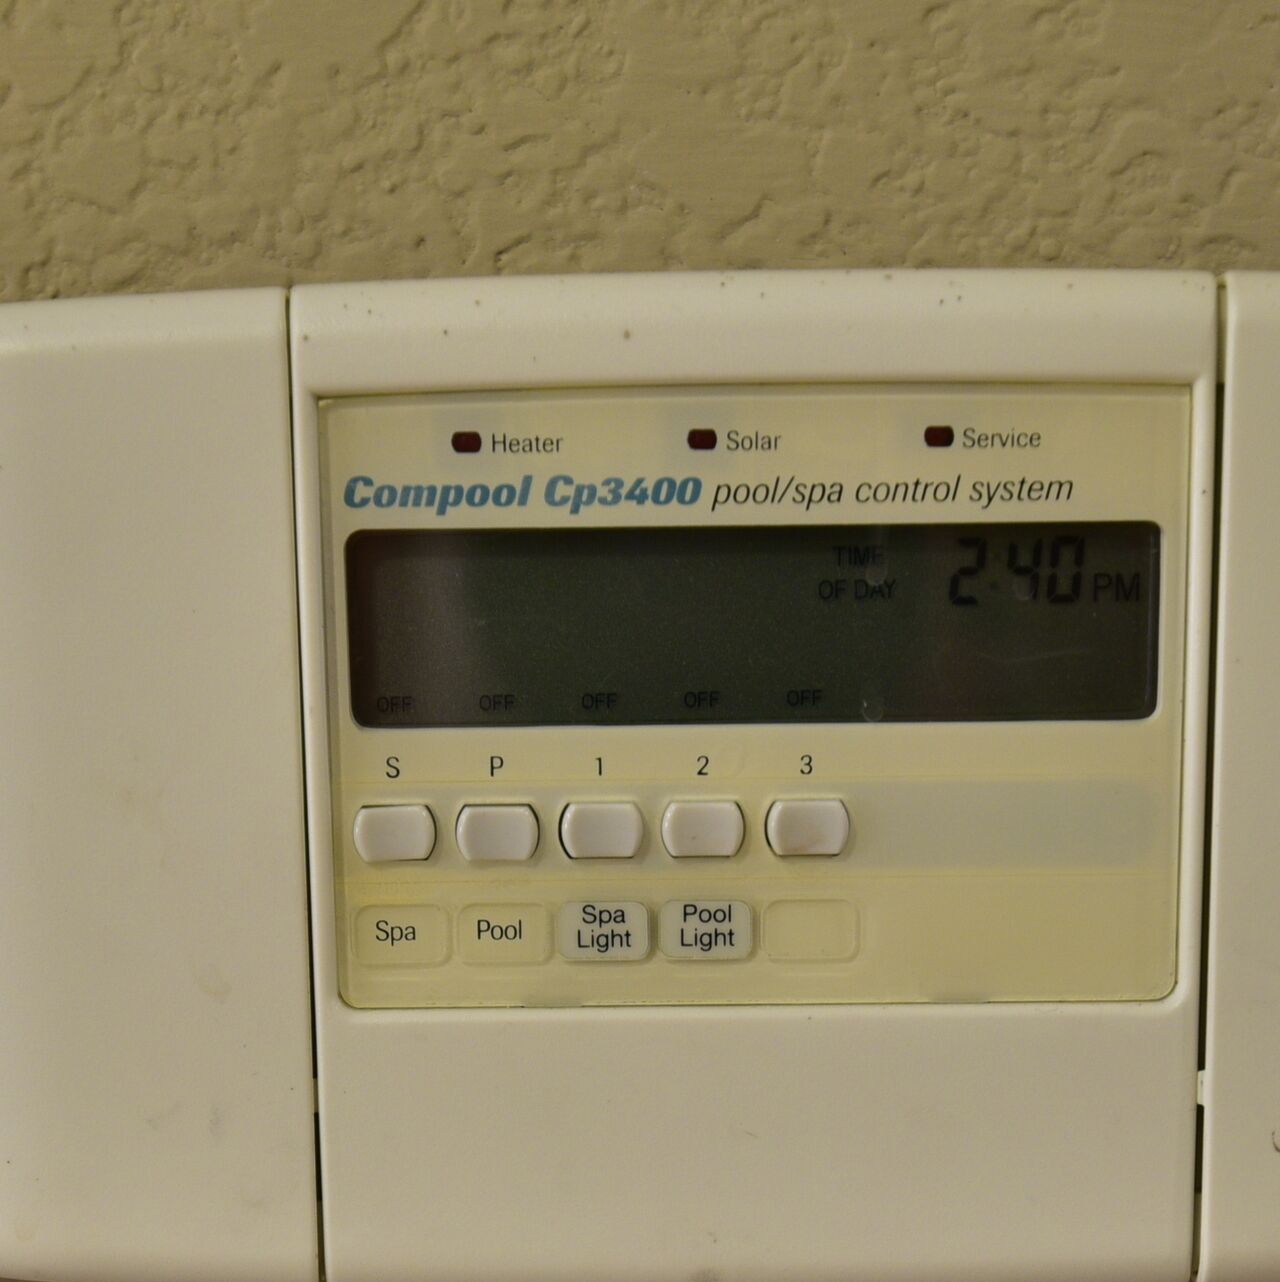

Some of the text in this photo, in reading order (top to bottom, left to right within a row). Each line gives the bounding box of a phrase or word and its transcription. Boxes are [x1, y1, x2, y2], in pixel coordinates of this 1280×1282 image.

[491, 431, 563, 455] Heater
[725, 428, 781, 453] Solar
[962, 426, 1042, 450] Service
[344, 474, 1074, 516] Compool Cp3400 pool/spa control system
[818, 579, 895, 601] OF DAY
[1093, 573, 1141, 601] PM
[376, 696, 412, 714] OFF
[479, 694, 514, 713] OFF
[581, 693, 617, 712] OFF
[684, 692, 719, 710] OFF
[787, 690, 823, 709] OFF
[385, 757, 401, 779] S
[490, 757, 504, 777] P
[595, 757, 602, 776] 1
[696, 756, 709, 776] 2
[800, 755, 813, 775] 3
[581, 905, 627, 930] Spa
[682, 905, 733, 925] Pool
[375, 921, 417, 946] Spa
[476, 919, 522, 942] Pool
[577, 928, 632, 952] Light
[680, 927, 735, 952] Light
